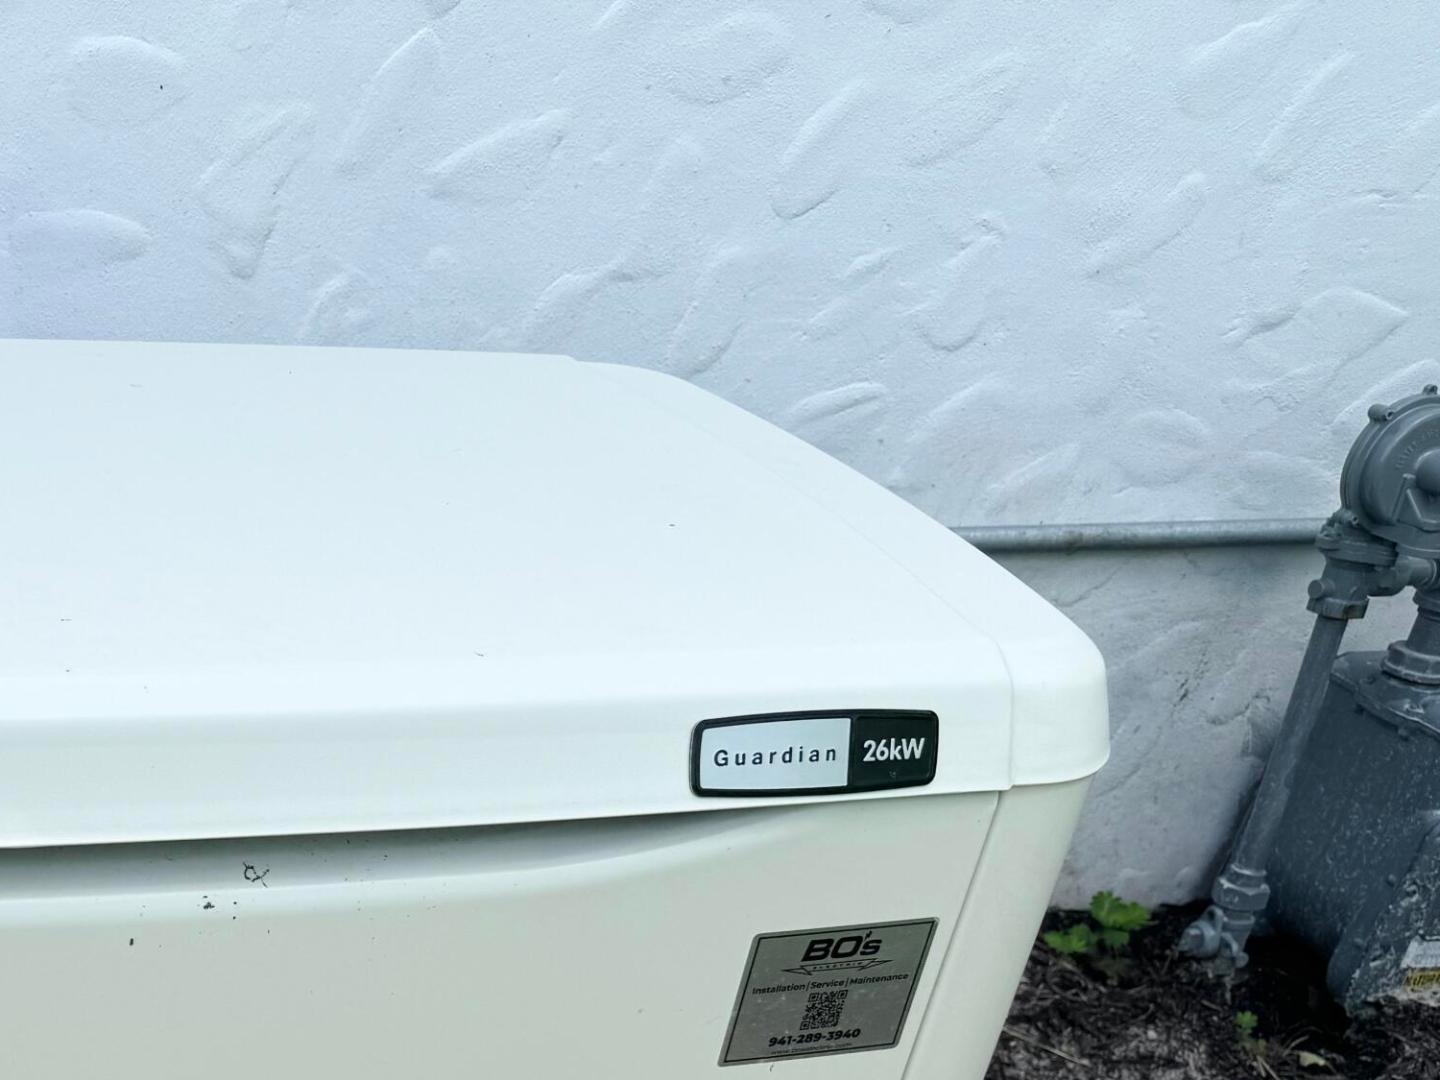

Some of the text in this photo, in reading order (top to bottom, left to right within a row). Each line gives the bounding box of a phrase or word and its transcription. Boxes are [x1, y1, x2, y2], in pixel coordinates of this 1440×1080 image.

[713, 737, 926, 767] Guardian 26kW
[768, 1028, 861, 1047] 941-289-3940
